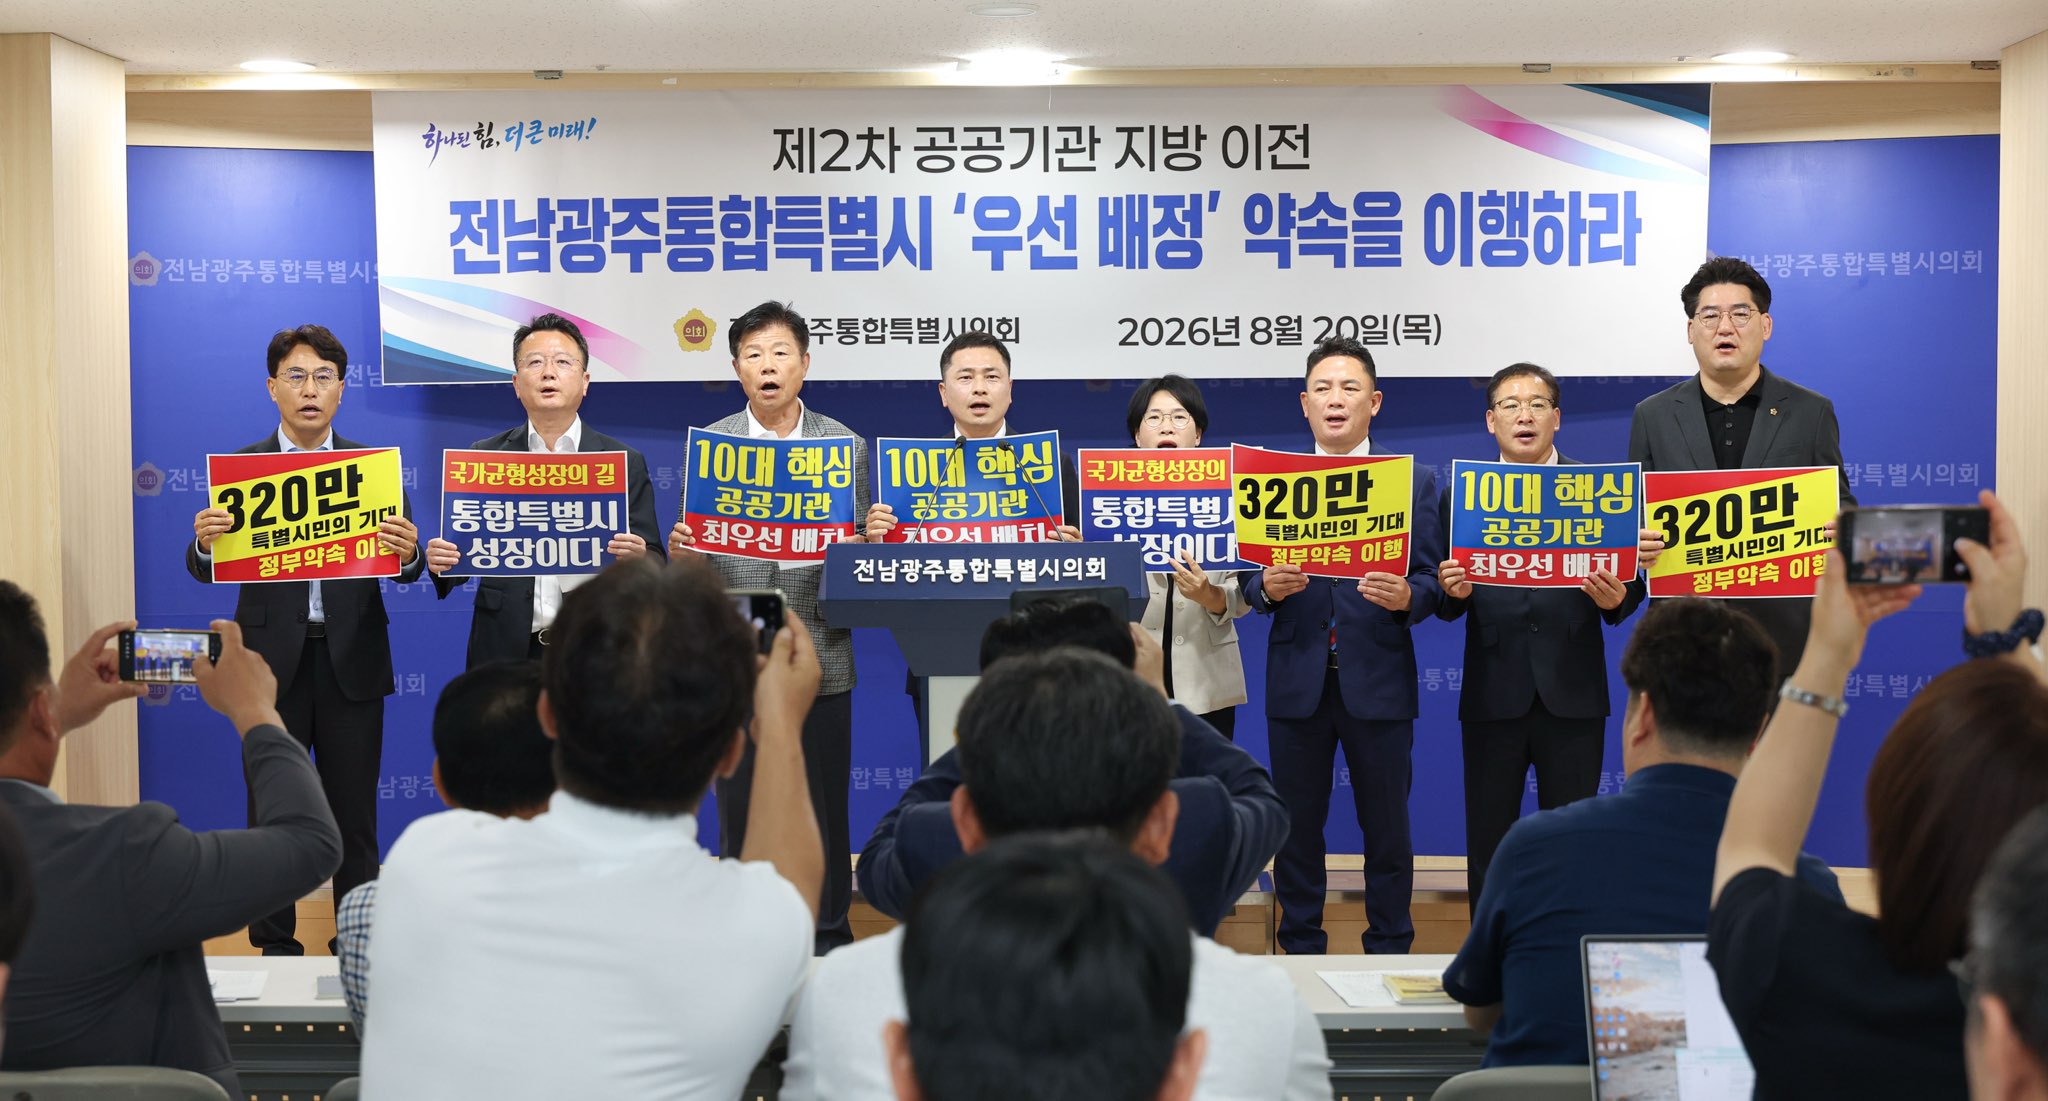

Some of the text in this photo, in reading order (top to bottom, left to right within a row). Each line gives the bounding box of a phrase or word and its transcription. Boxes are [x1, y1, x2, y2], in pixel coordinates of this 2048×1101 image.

[422, 122, 471, 168] 하나된
[473, 121, 500, 150] 힘,
[548, 117, 597, 141] 미래!
[774, 124, 1310, 173] 제2차 공공기관 지방 이전
[449, 195, 932, 274] 전남광주통합특별시
[1244, 192, 1402, 268] 약속을
[1424, 190, 1641, 266] 이행하라
[1728, 250, 1982, 278] 남광주통합특별시의회
[685, 326, 705, 337] 의회
[1118, 314, 1441, 346] 2026년 8월 20일(목)
[450, 461, 615, 486] 국가균형성장의 길
[696, 439, 775, 488] 10대
[787, 445, 851, 488] 핵심
[886, 440, 1054, 488] 10대 핵심
[1086, 459, 1226, 483] 국가균형성장의
[218, 464, 363, 534] 320만
[714, 486, 832, 520] 공공기관
[910, 489, 1029, 520] 공공기관
[1239, 469, 1373, 520] 320만
[1461, 471, 1542, 514] 10대
[1554, 472, 1633, 514] 핵심
[251, 515, 350, 549] 특별시민의
[450, 499, 618, 533] 통합특별시
[1265, 512, 1404, 541] 특별시민의 기대
[1481, 517, 1605, 546] 공공기관
[1653, 482, 1799, 550] 320만
[702, 519, 782, 553] 최우선
[1685, 534, 1785, 566] 특별시민의
[258, 544, 346, 577] 정부약속
[466, 537, 604, 569] 성장이다
[1271, 538, 1403, 567] 정부약속 이행
[1469, 553, 1619, 579] 최우선 배치
[853, 557, 1106, 583] 전남광주통합특별시의회
[1692, 562, 1780, 594] 정부약속
